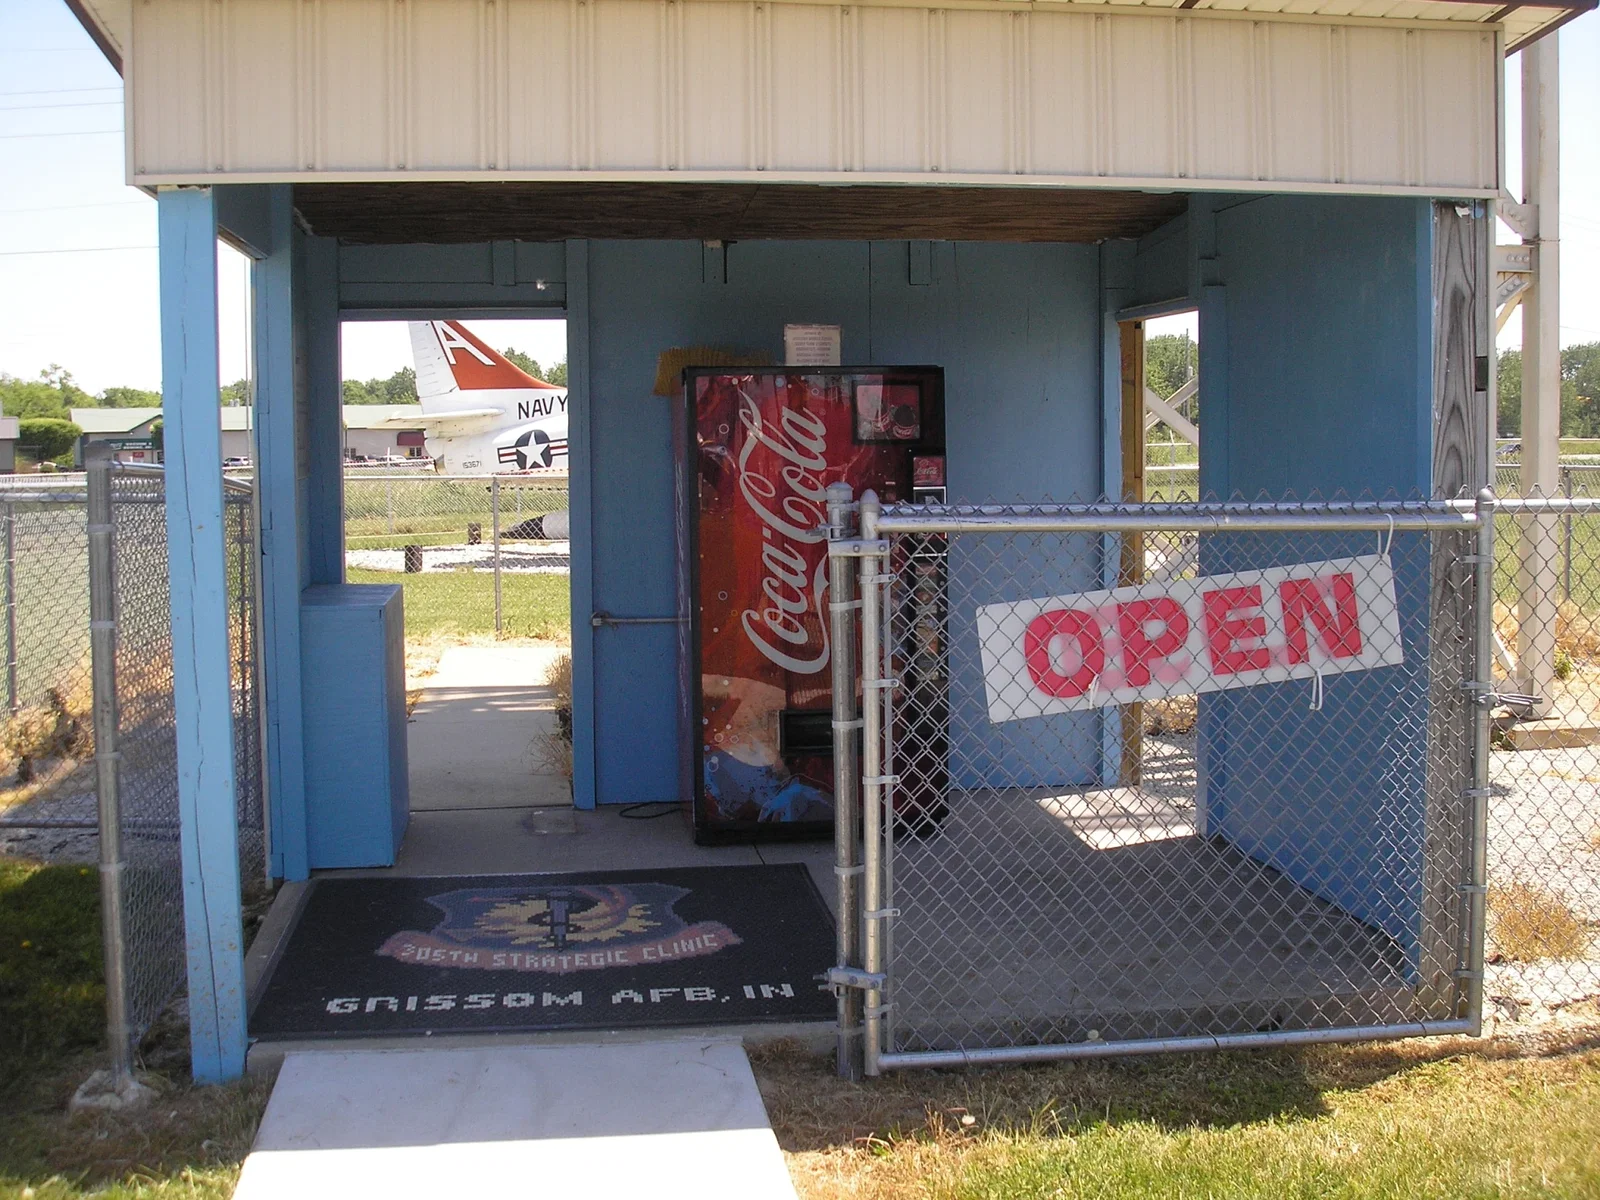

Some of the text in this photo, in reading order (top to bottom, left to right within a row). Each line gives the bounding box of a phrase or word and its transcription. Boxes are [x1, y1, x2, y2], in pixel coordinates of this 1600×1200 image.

[517, 395, 568, 420] NAVY
[738, 389, 830, 675] Coca-Cola
[1024, 572, 1362, 698] OPEN
[401, 933, 718, 970] 305TH STRATEGIC CLINIC
[325, 990, 583, 1014] GRISSOM
[742, 983, 795, 999] IN
